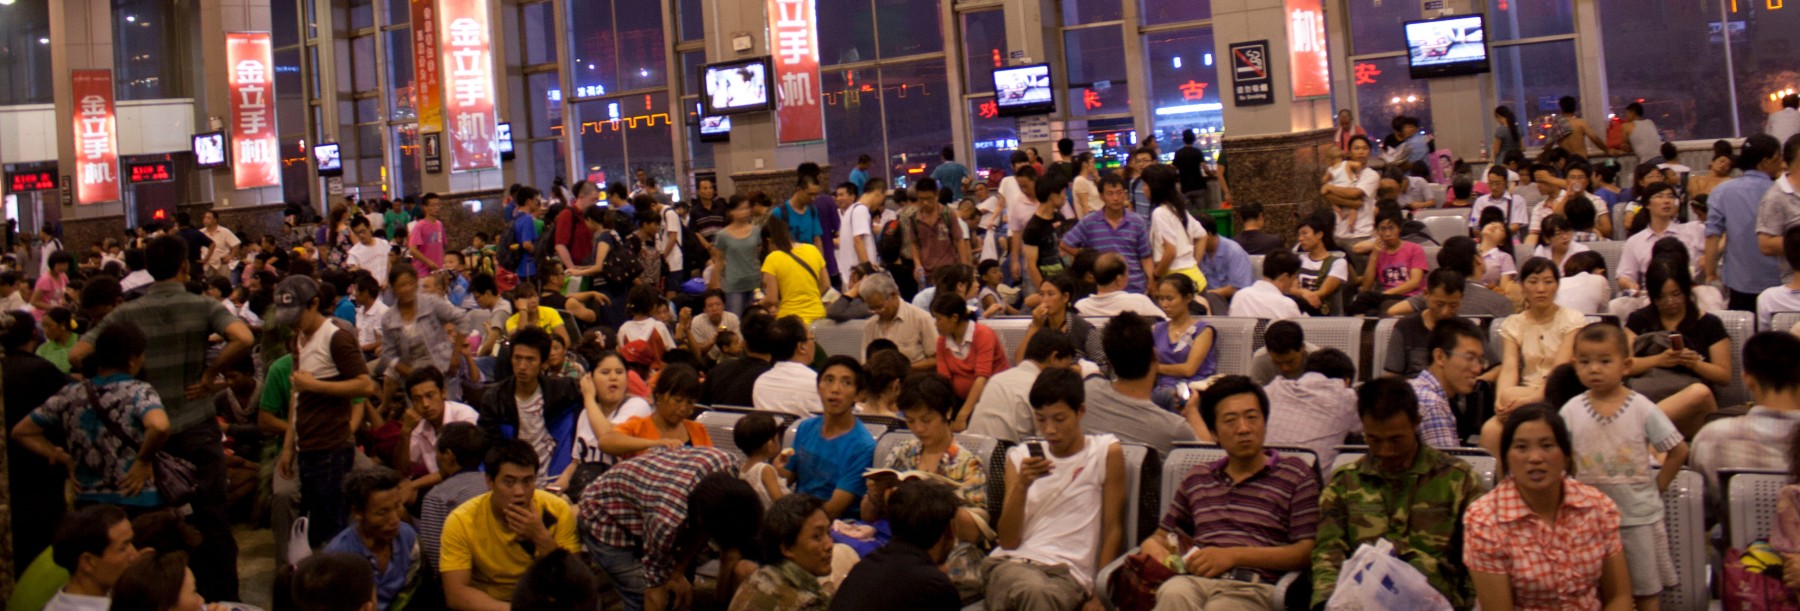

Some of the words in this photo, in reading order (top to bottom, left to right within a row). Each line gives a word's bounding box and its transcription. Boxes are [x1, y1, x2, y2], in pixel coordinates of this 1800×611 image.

[776, 0, 816, 107] 立手机
[1291, 8, 1320, 52] 机
[236, 59, 272, 164] 金立手机
[449, 17, 489, 141] 金立手机
[1179, 79, 1208, 101] 古
[80, 94, 113, 184] 金立手机
